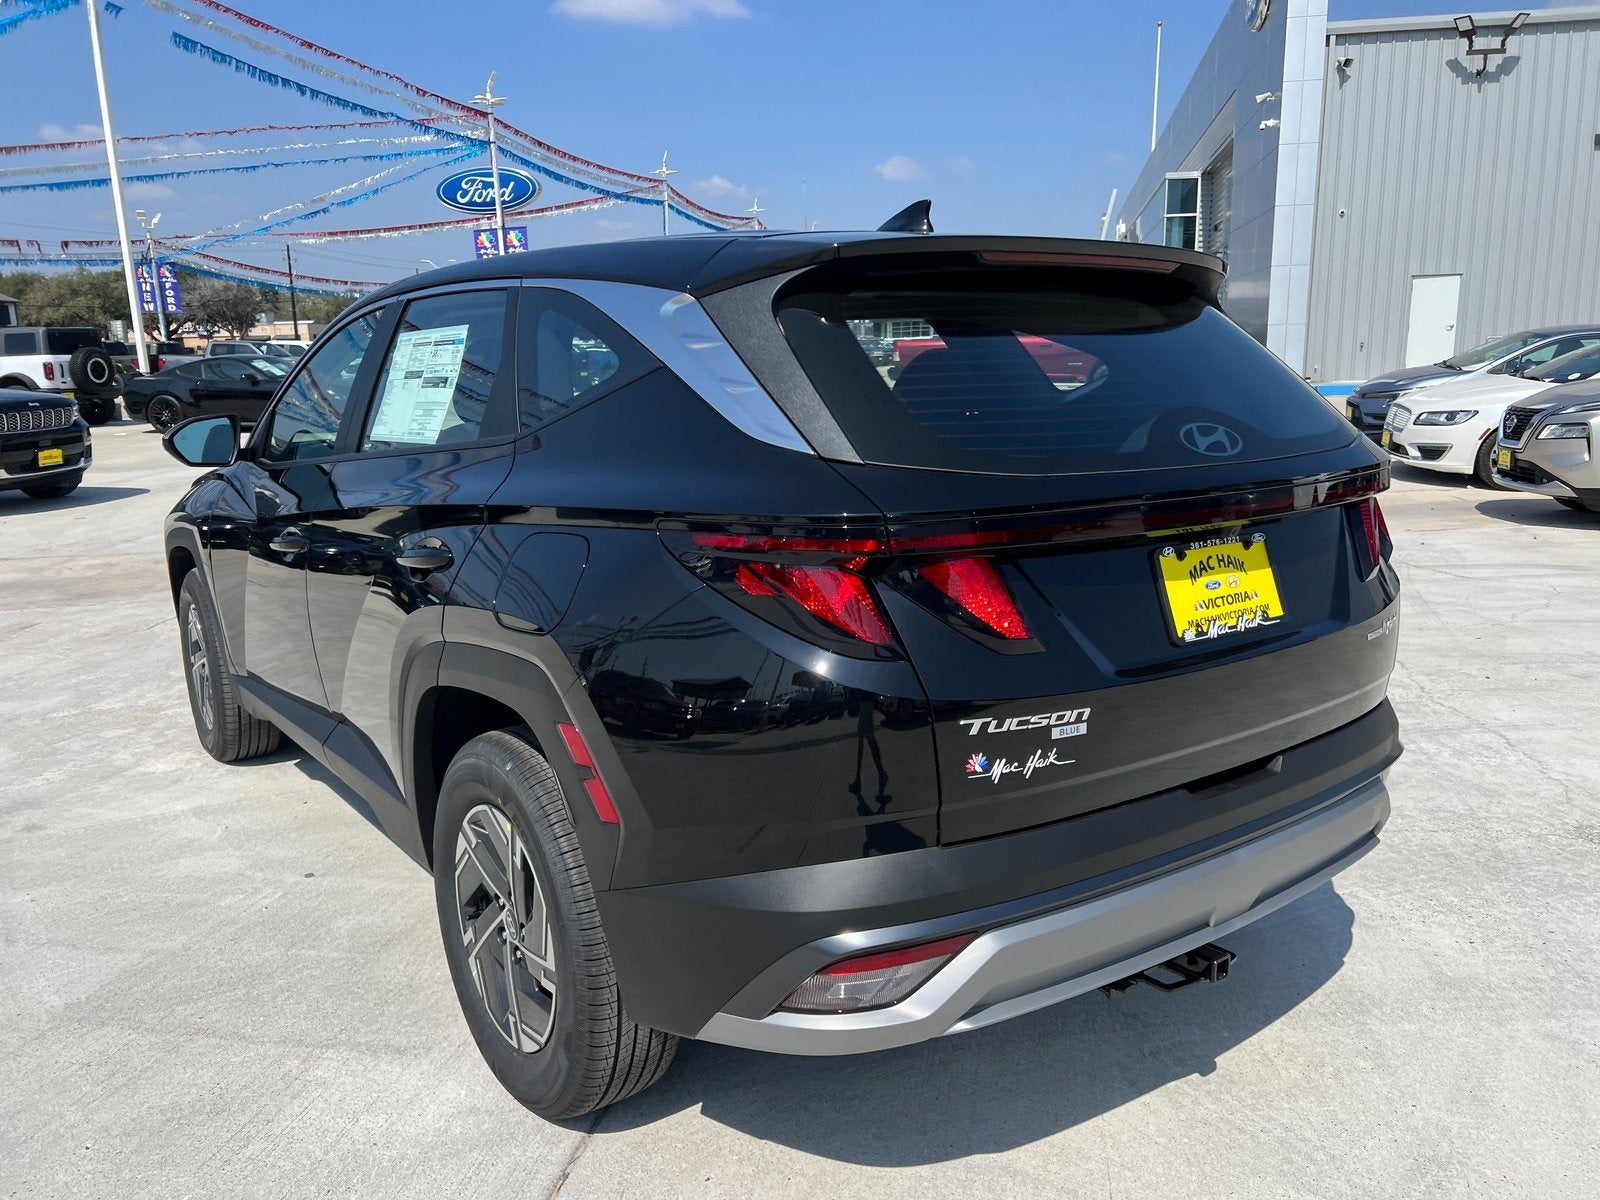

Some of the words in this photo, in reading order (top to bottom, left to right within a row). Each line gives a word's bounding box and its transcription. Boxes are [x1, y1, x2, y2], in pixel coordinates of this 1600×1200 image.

[457, 176, 515, 204] Ford
[141, 282, 154, 311] NEW
[165, 282, 176, 311] FORD
[1189, 555, 1215, 585] MAC
[1216, 554, 1248, 575] HAIK
[1202, 591, 1252, 610] VICTORIA
[1207, 620, 1238, 638] Mac
[960, 707, 1091, 735] TUCSON
[1059, 725, 1081, 736] BLUE
[989, 758, 1024, 784] Mac
[1023, 747, 1076, 779] Haik
